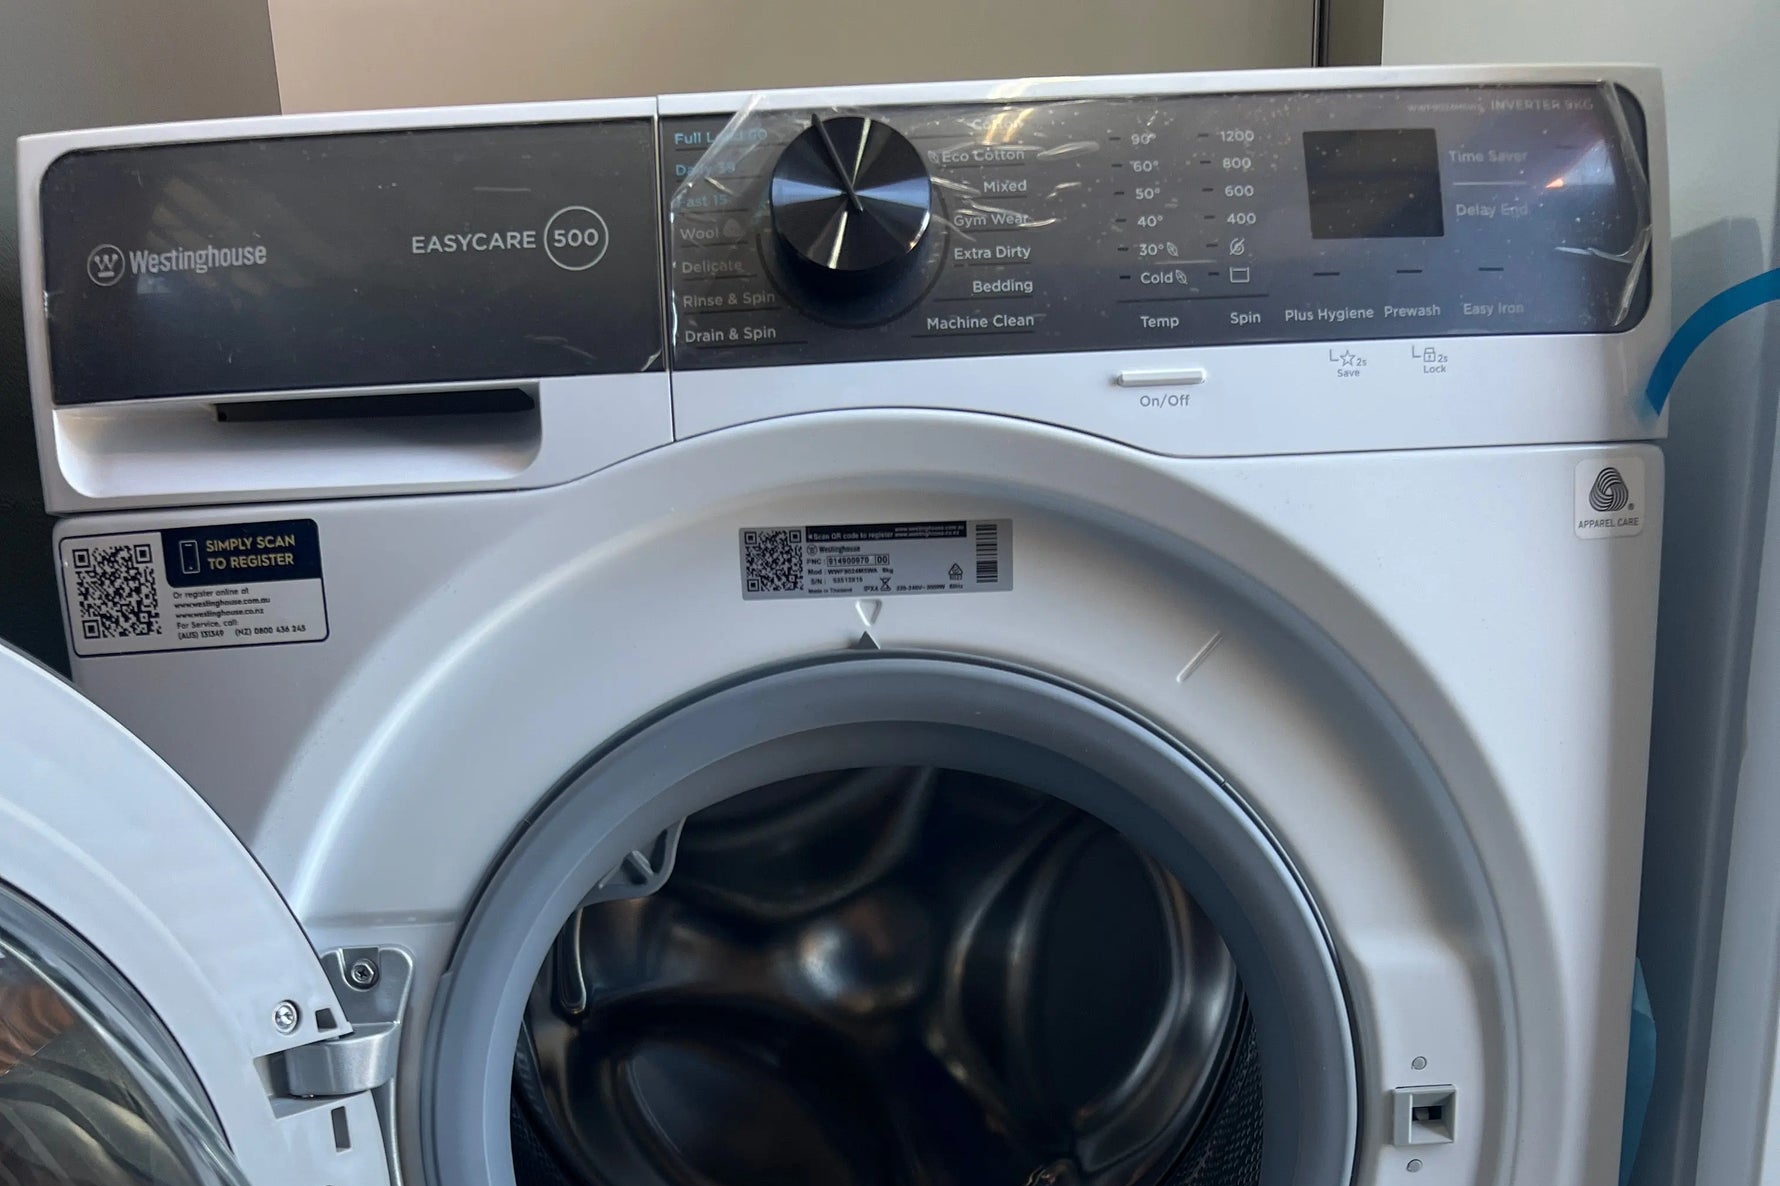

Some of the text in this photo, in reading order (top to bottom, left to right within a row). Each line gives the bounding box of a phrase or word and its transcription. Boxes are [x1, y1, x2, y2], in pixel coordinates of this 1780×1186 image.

[1491, 99, 1560, 110] INVERTER
[675, 132, 701, 144] Full
[1221, 130, 1254, 142] 1200
[942, 150, 1024, 162] Eco Cotton
[1449, 150, 1528, 163] Time Saver
[1133, 160, 1158, 172] 60°
[1223, 158, 1251, 169] 800
[984, 180, 1027, 192] Mixed
[1225, 185, 1254, 196] 600
[1136, 187, 1160, 199] 50°
[1456, 204, 1528, 217] Delay End
[954, 214, 1028, 228] Gym Wear
[1137, 215, 1163, 227] 40°
[1227, 213, 1256, 224] 400
[680, 228, 719, 240] Wool
[412, 228, 598, 254] EASYCARE 500
[954, 247, 1031, 259] Extra Dirty
[1139, 243, 1164, 256] 30°
[130, 244, 266, 275] Westinghouse
[682, 261, 743, 273] Delicate
[1140, 272, 1173, 284] Cold
[973, 280, 1033, 293] Bedding
[683, 291, 775, 308] Rinse & Spin
[1285, 308, 1374, 322] Plus Hygiene
[1384, 305, 1440, 318] Prewash
[1464, 303, 1524, 316] Easy Iron
[927, 315, 1034, 330] Machine Clean
[1140, 316, 1179, 328] Temp
[1230, 312, 1261, 325] Spin
[685, 326, 776, 342] Drain & Spin
[1337, 369, 1360, 377] Save
[1424, 365, 1446, 373] Lock
[1140, 394, 1190, 408] On/Off
[1578, 517, 1639, 528] APPAREL CARE
[206, 535, 295, 552] SIMPLY SCAN
[208, 554, 294, 569] TO REGISTER
[877, 556, 888, 564] 00
[185, 590, 213, 600] register
